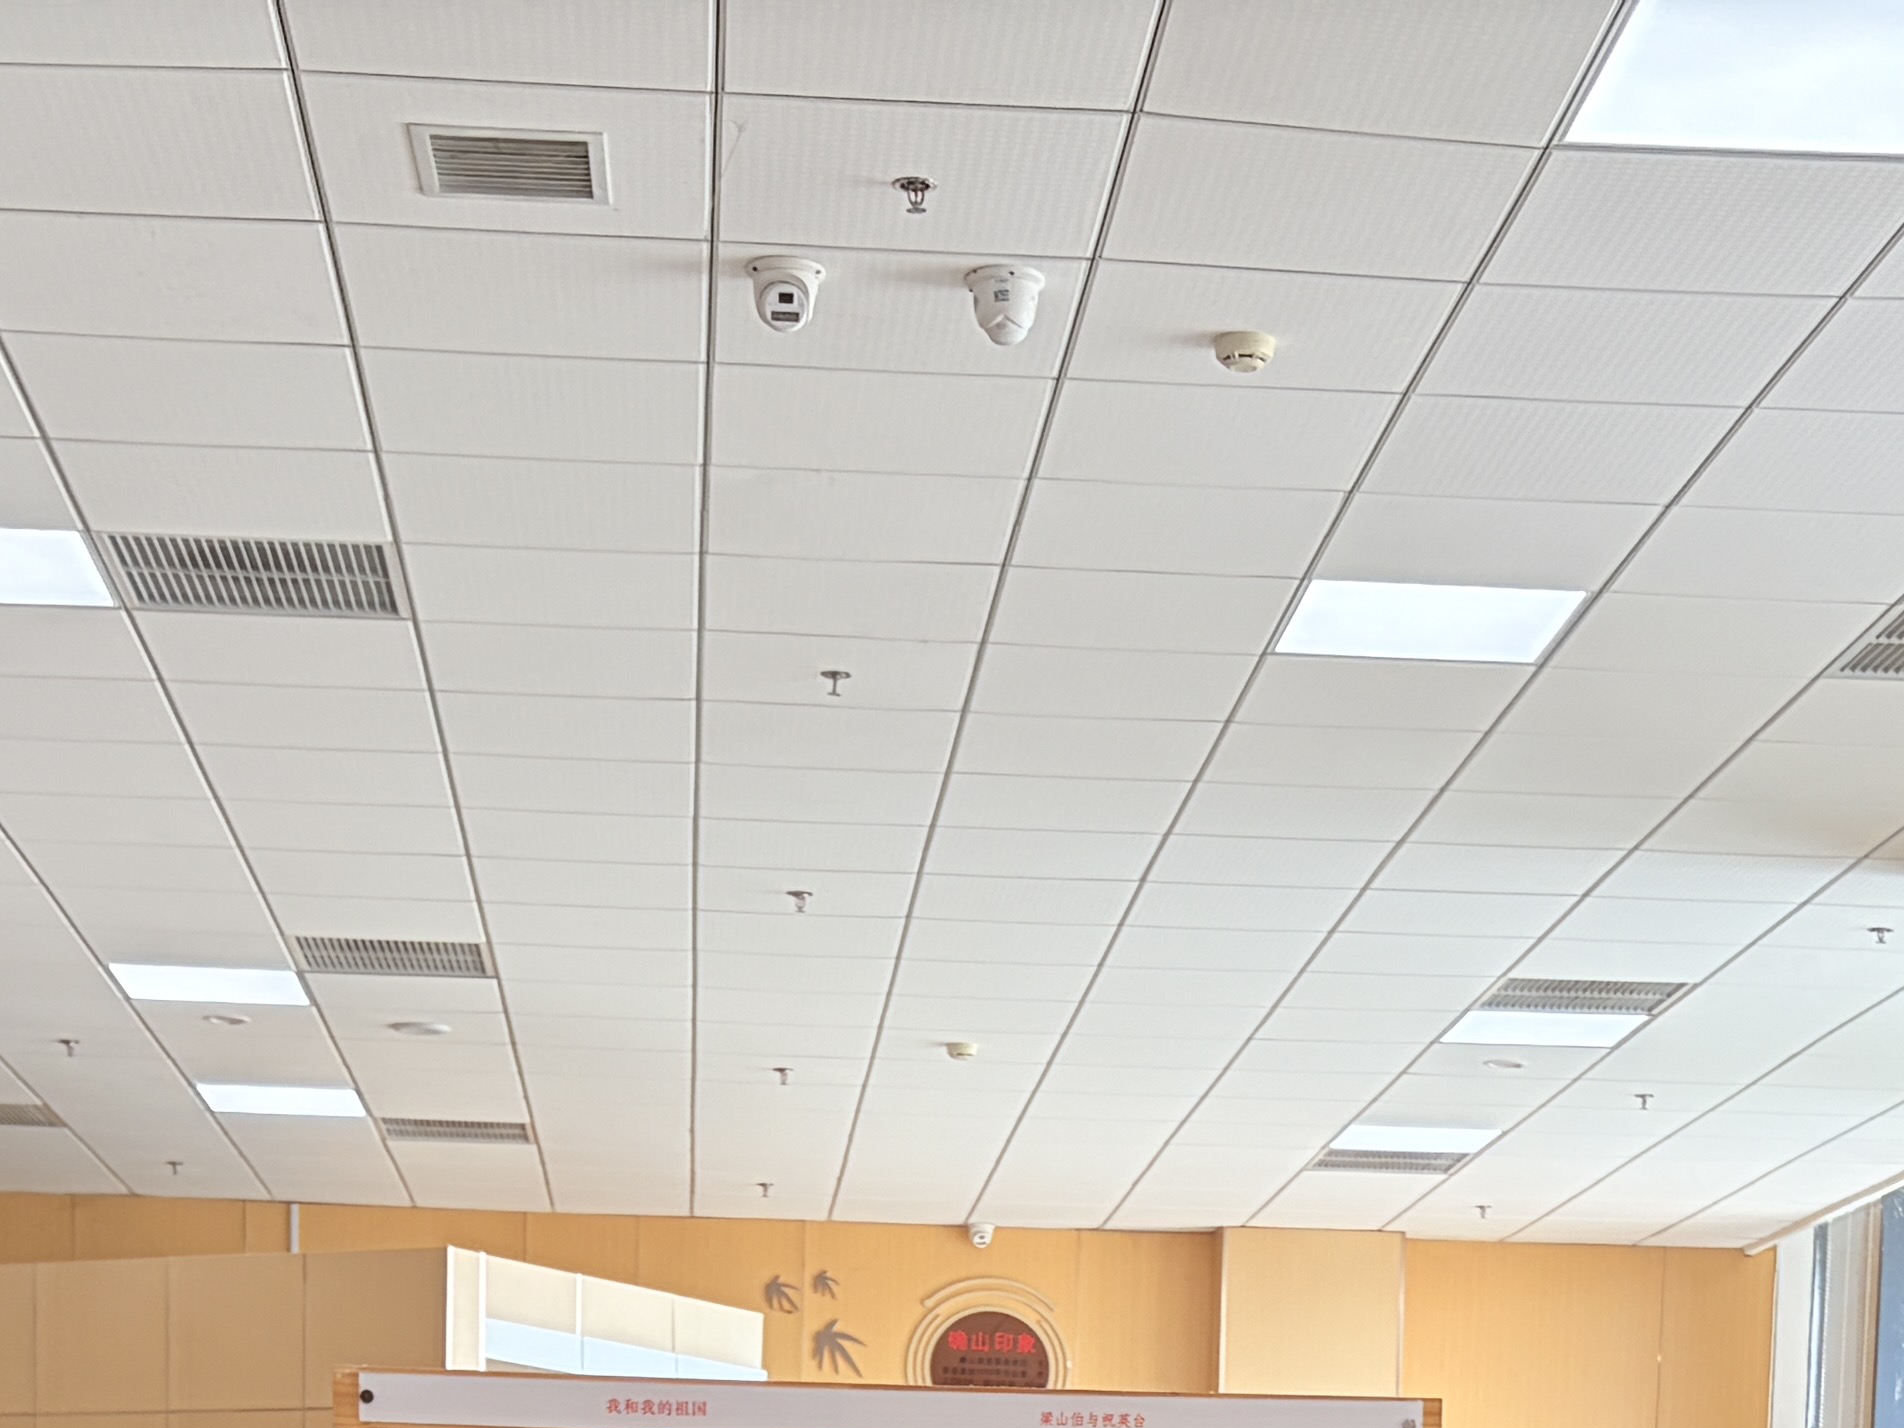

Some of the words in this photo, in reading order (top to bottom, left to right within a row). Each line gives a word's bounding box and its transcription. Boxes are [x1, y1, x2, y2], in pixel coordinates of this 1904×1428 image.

[605, 1397, 708, 1417] 我和我的祖国
[1038, 1410, 1146, 1428] 梁山伯与祝英台
